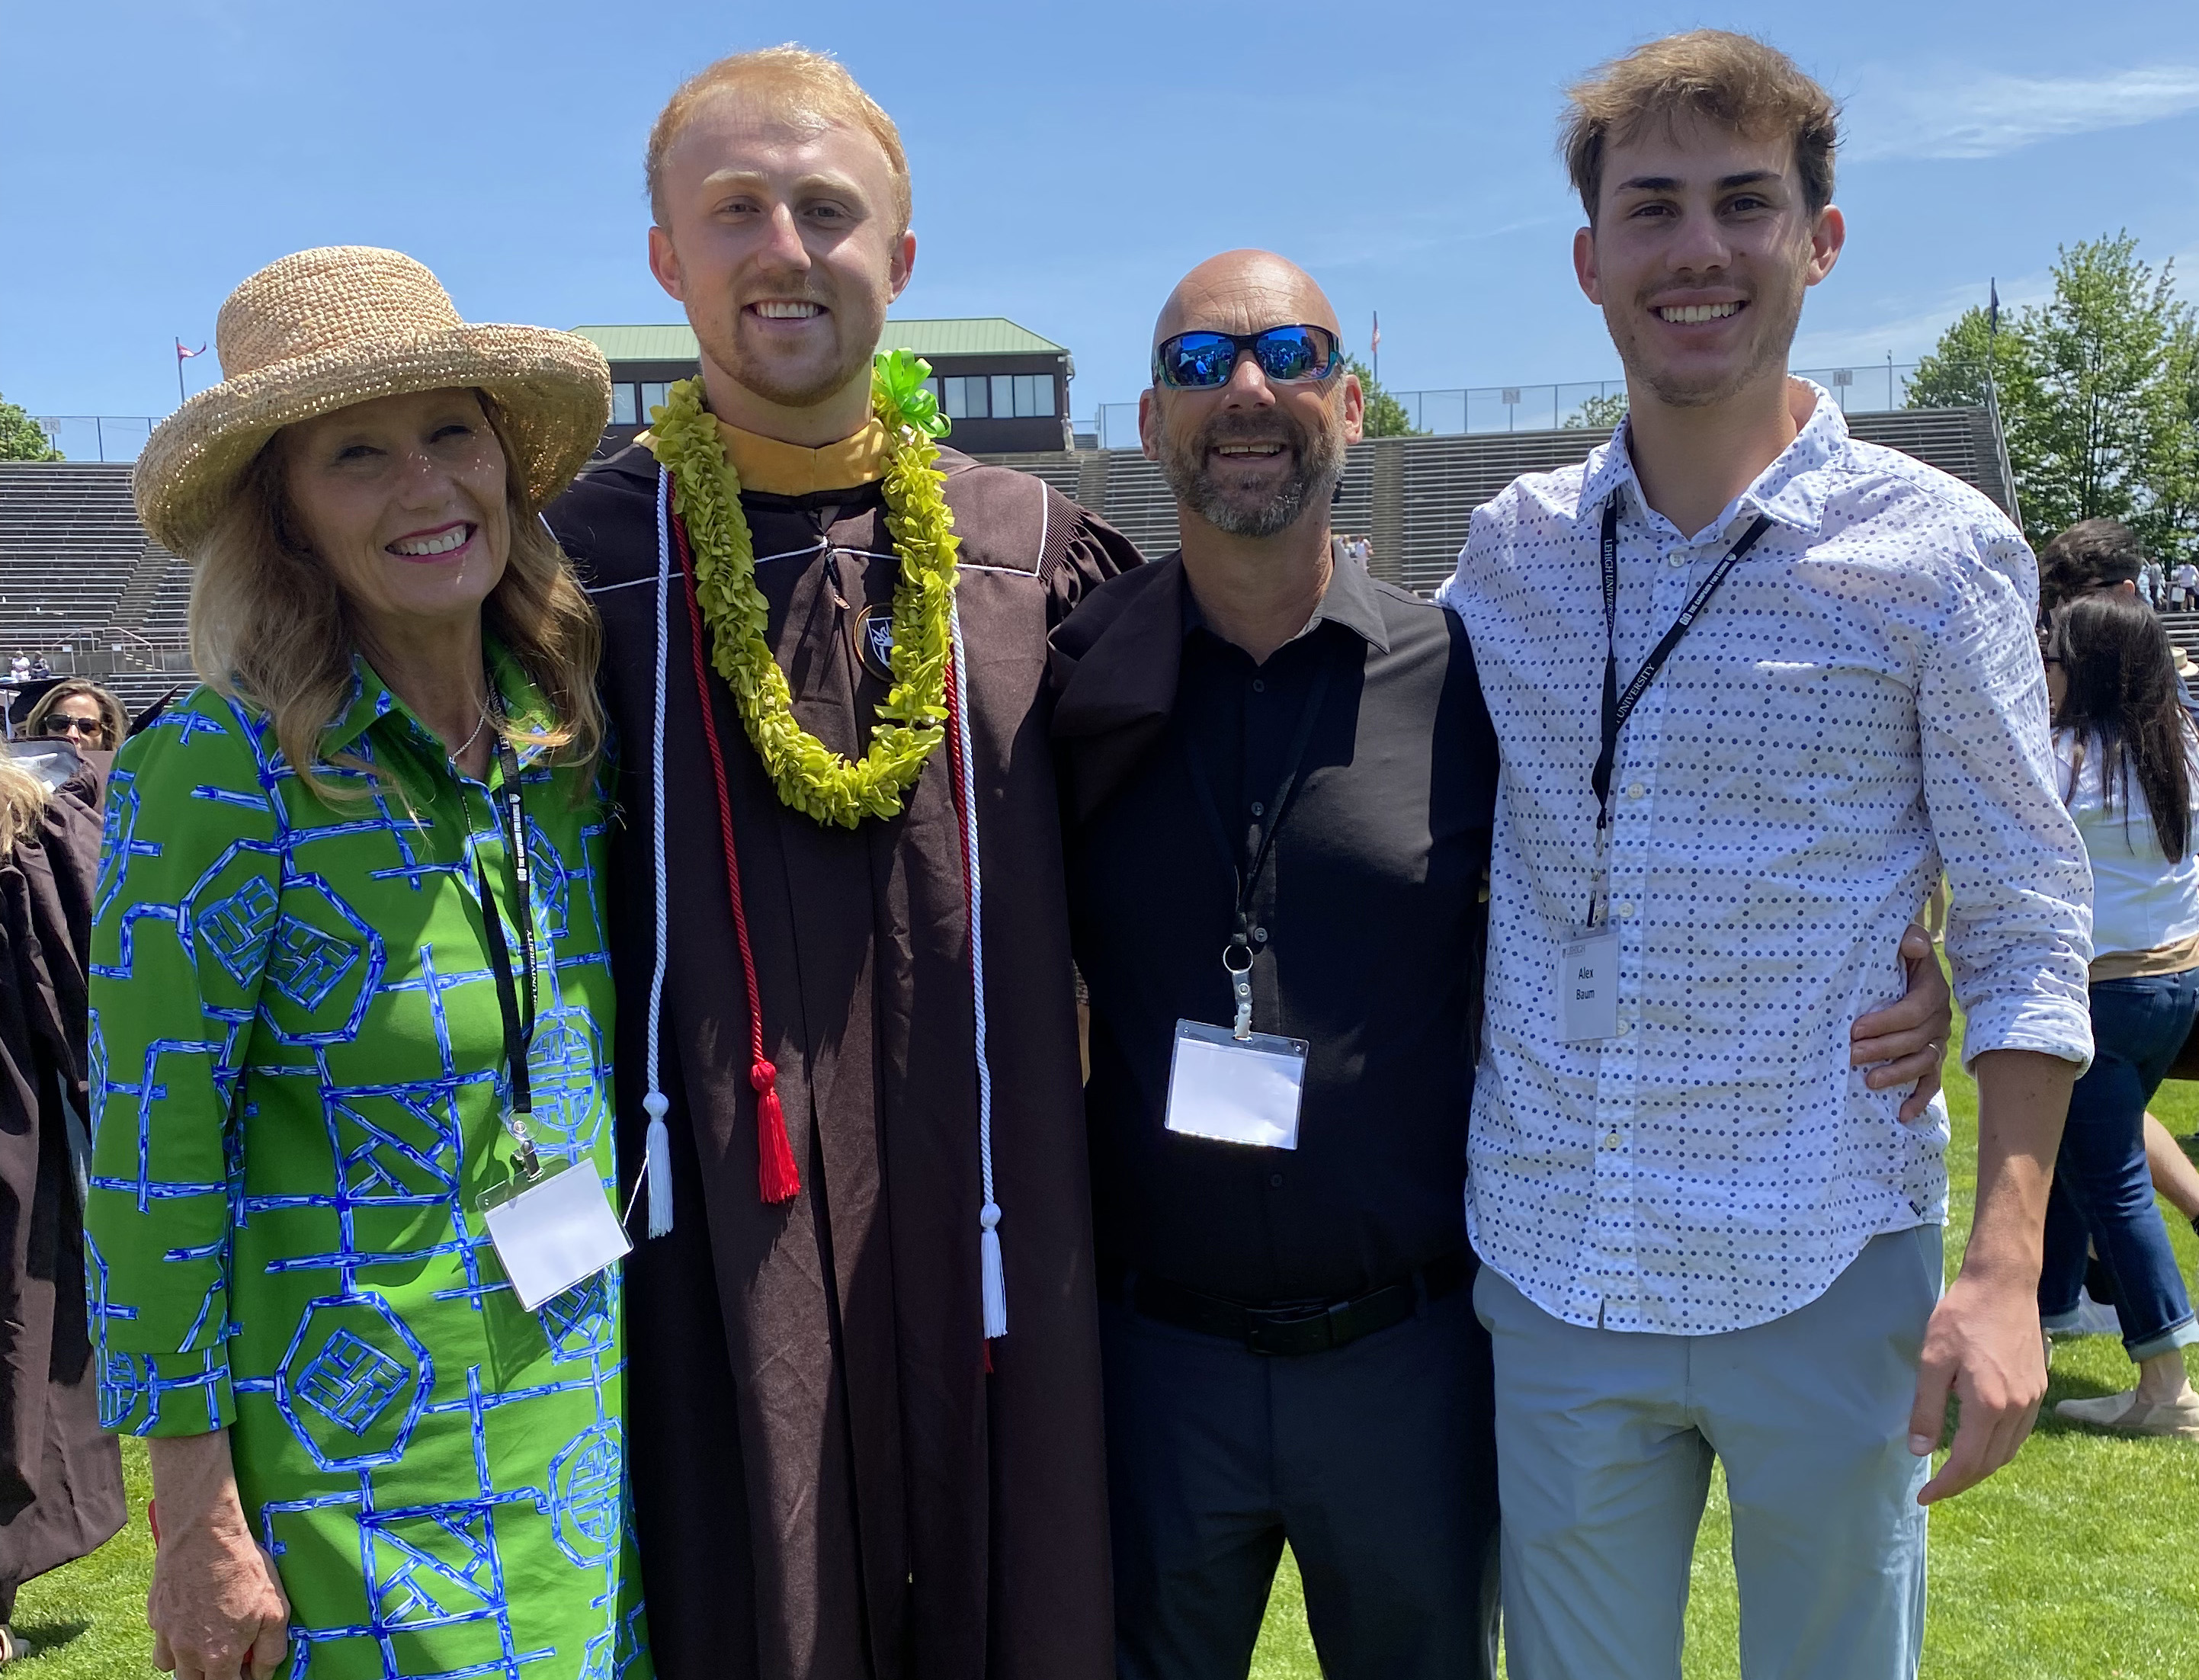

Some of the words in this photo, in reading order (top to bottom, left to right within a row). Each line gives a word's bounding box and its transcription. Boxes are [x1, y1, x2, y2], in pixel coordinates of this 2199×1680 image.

[43, 421, 58, 431] ER
[1604, 538, 1614, 572] LEHIGH
[1678, 612, 1693, 626] GO
[1616, 662, 1655, 718] UNIVERSITY
[517, 867, 527, 881] GO
[527, 929, 537, 992] UNIVERSITY
[1578, 966, 1594, 979] Alex
[1576, 989, 1595, 1000] Baum
